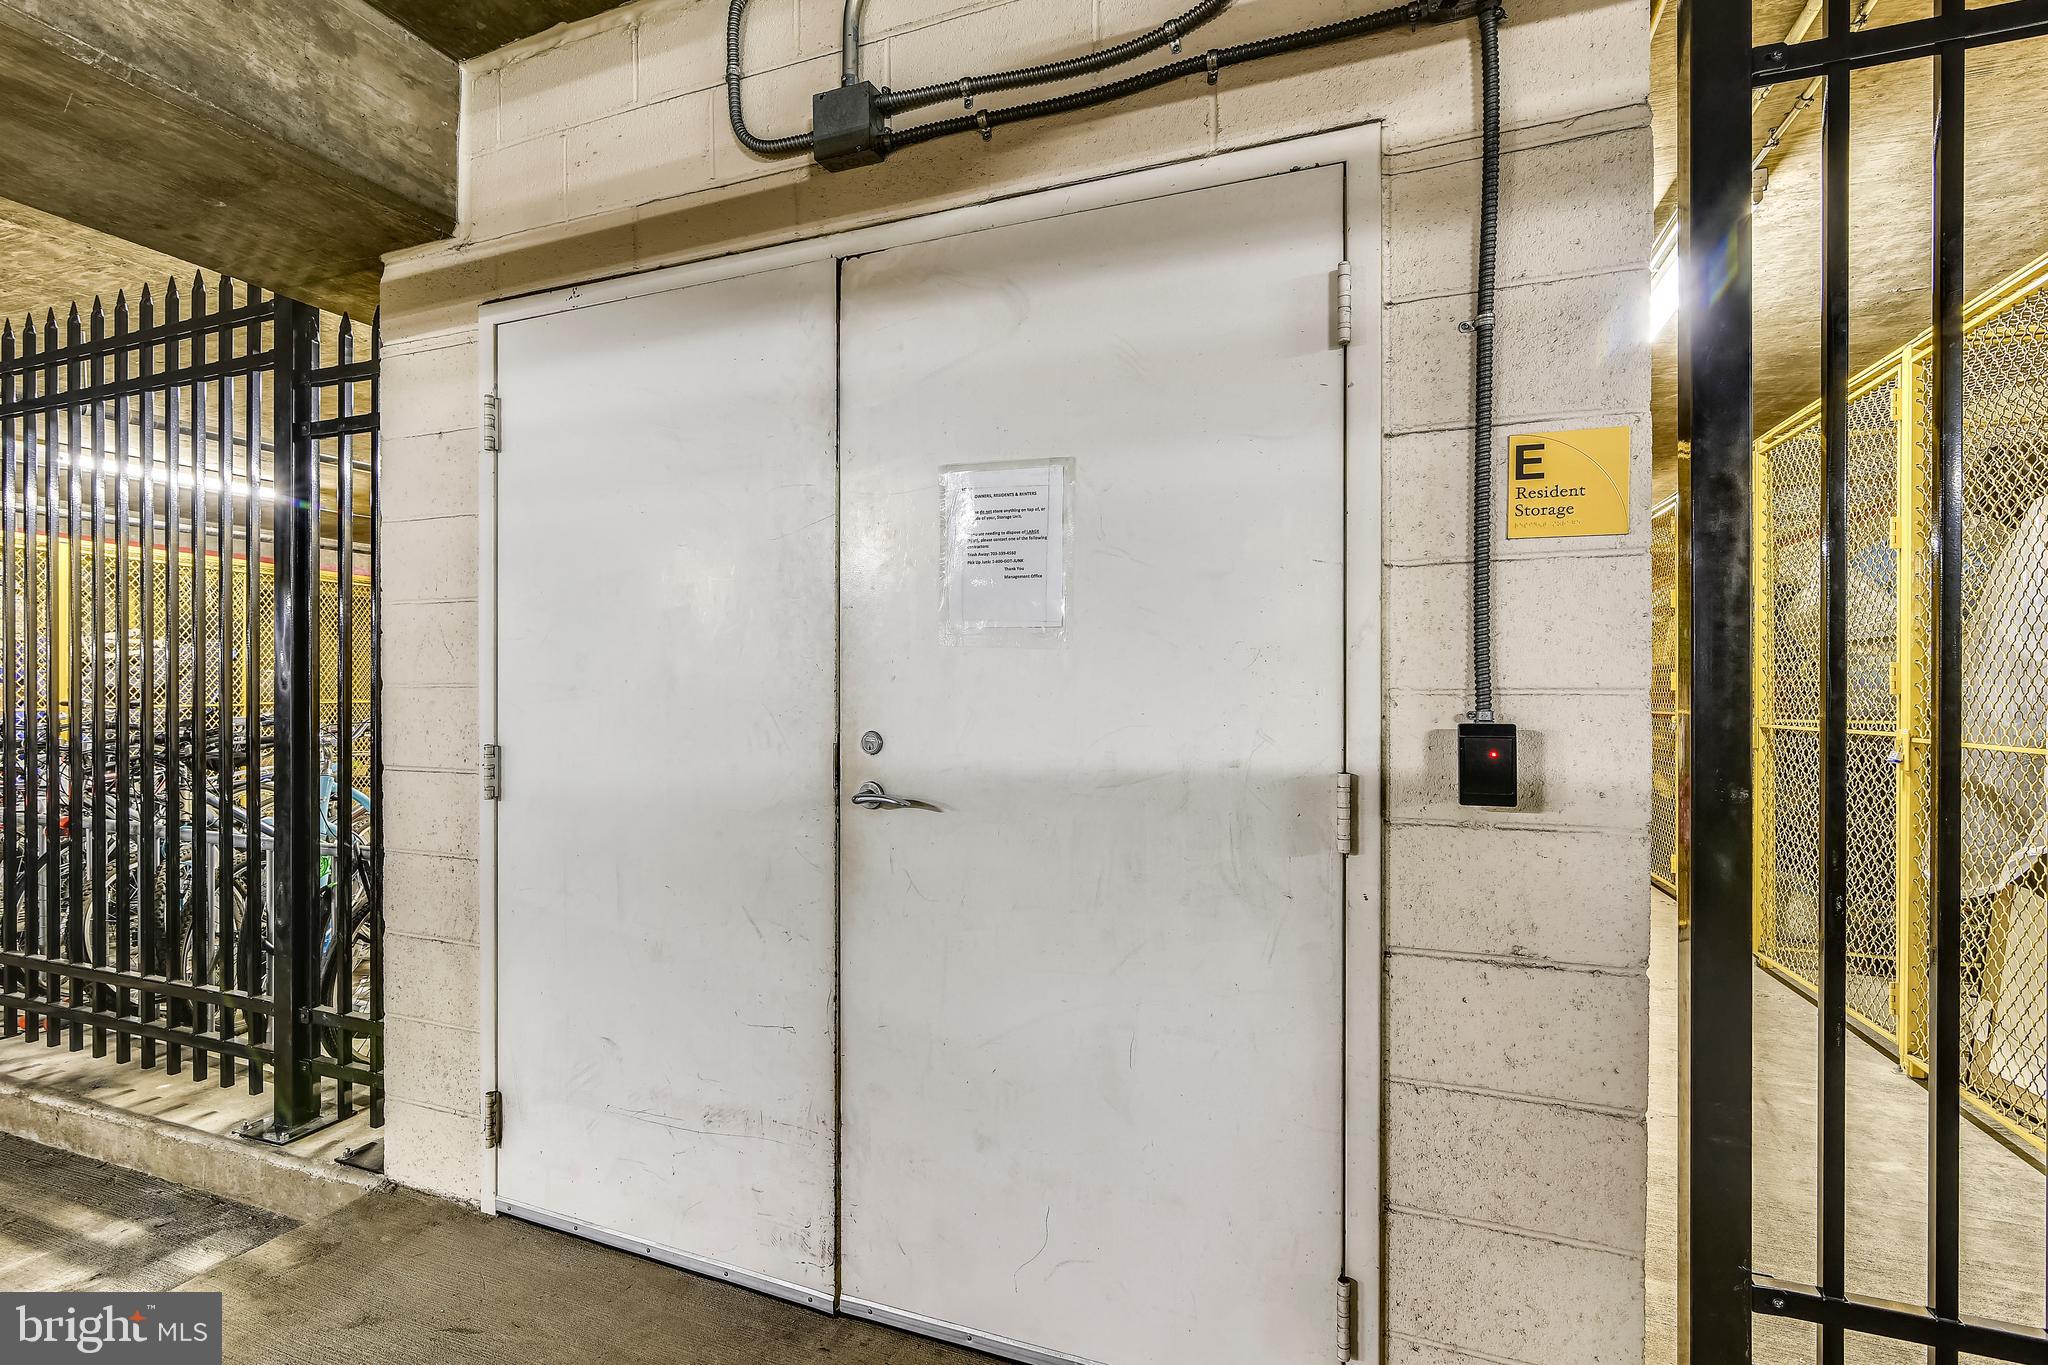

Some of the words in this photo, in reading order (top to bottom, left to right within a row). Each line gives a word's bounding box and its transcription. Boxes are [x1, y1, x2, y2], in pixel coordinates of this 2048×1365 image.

[1515, 443, 1545, 480] E
[1515, 485, 1586, 500] Resident
[1514, 503, 1575, 519] Storage
